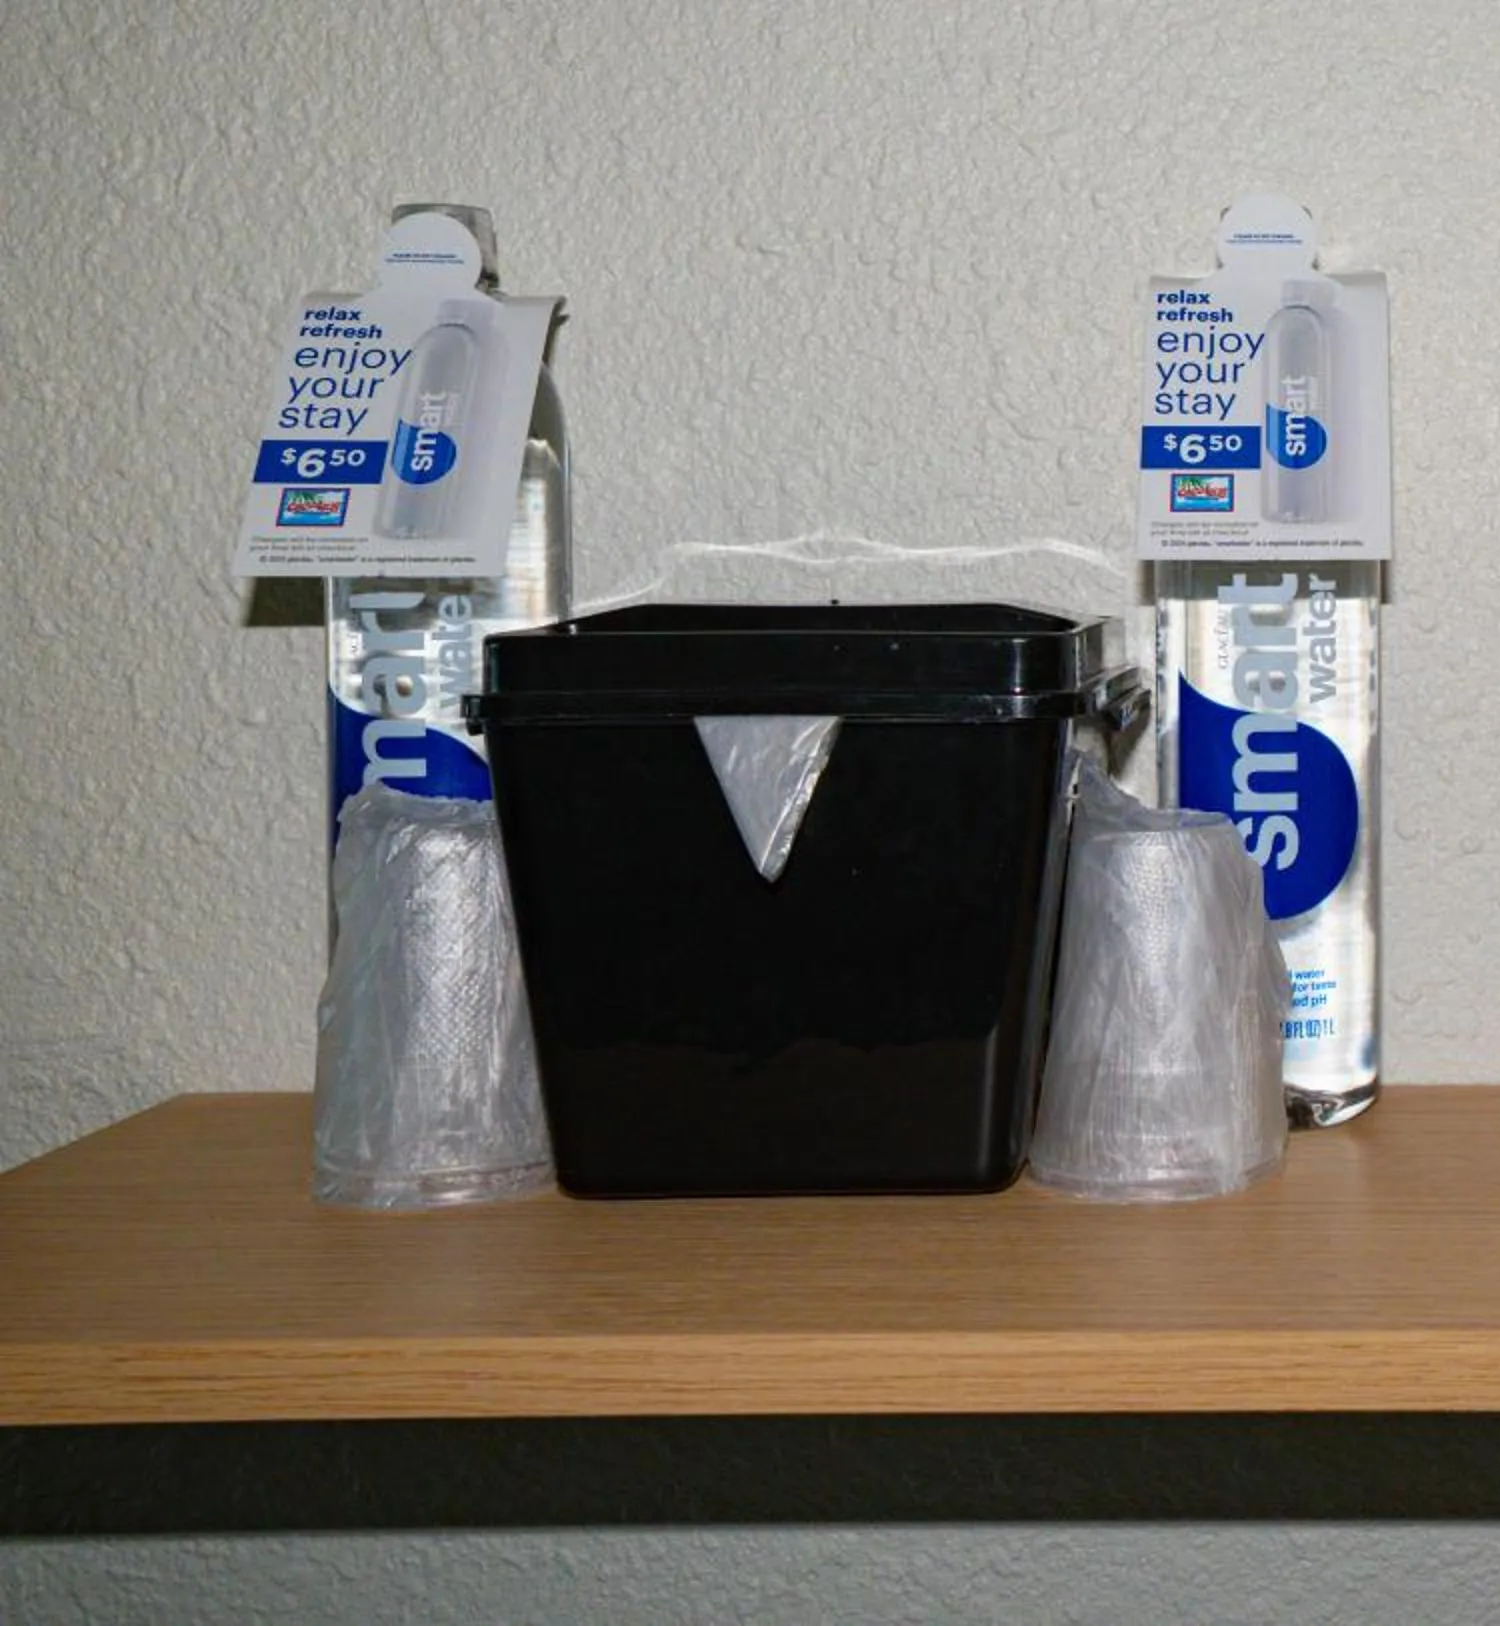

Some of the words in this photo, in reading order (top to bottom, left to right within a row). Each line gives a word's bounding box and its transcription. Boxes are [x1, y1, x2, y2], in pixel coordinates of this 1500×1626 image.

[1157, 290, 1210, 304] relax
[304, 307, 361, 321] relax
[1157, 307, 1233, 323] refresh
[300, 323, 382, 339] refresh
[1157, 326, 1265, 359] enjoy
[295, 342, 412, 375] enjoy
[288, 375, 384, 404] your
[1156, 362, 1245, 388] your
[279, 403, 368, 435] stay
[1155, 388, 1235, 420] stay
[411, 391, 447, 471] smart
[432, 594, 473, 710] wate
[1302, 572, 1337, 704] water
[349, 591, 426, 788] mart
[1218, 572, 1299, 871] smart
